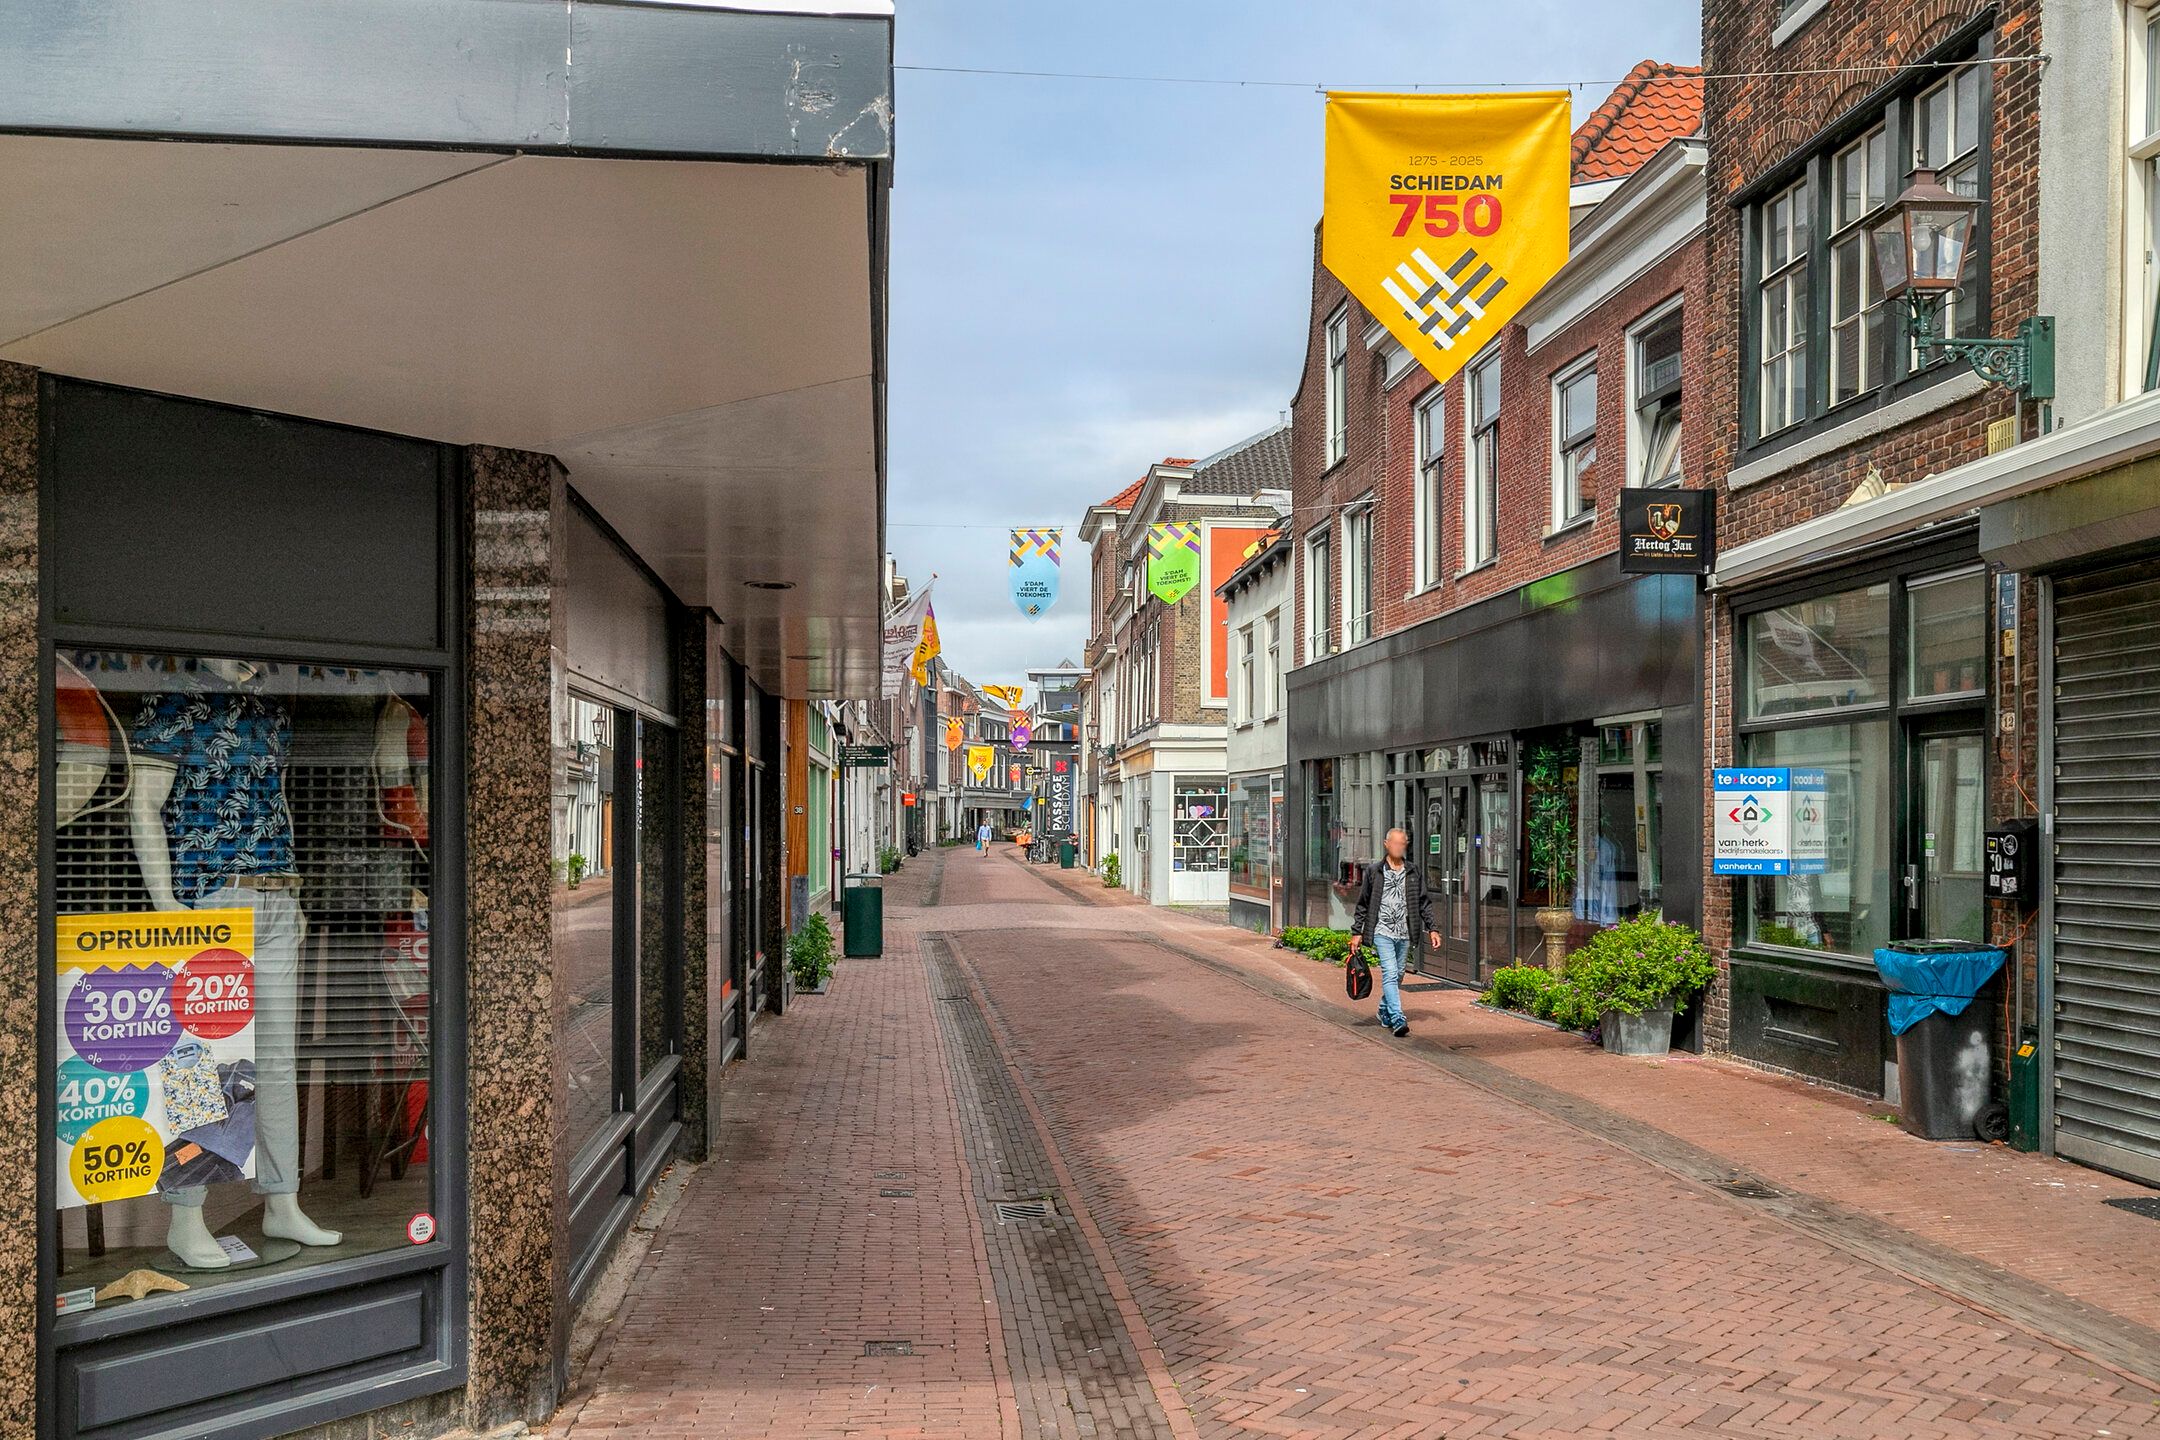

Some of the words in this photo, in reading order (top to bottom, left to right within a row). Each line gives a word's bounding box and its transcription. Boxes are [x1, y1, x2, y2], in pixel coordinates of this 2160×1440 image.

[1409, 156, 1438, 166] 1275
[1449, 155, 1484, 166] 2025
[1390, 174, 1503, 191] SCHIEDAM
[1389, 194, 1503, 237] 750
[1634, 538, 1671, 553] Hertog
[1671, 538, 1692, 553] Jan
[1718, 774, 1733, 785] te
[1740, 773, 1777, 788] koop
[794, 806, 803, 814] 38
[1053, 775, 1062, 831] PASSAGE
[1062, 774, 1070, 831] SCHIEDAM
[1718, 847, 1781, 856] bedrijfsmakelaars
[1742, 838, 1764, 847] herk
[76, 924, 232, 952] OPRUIMING
[185, 973, 249, 1002] 20%
[84, 987, 171, 1024] 30%
[184, 998, 250, 1015] KORTING
[82, 1019, 172, 1042] KORTING
[58, 1075, 136, 1107] 40%
[58, 1101, 136, 1122] KORTING
[84, 1140, 150, 1171] 50%
[84, 1165, 151, 1186] KORTING
